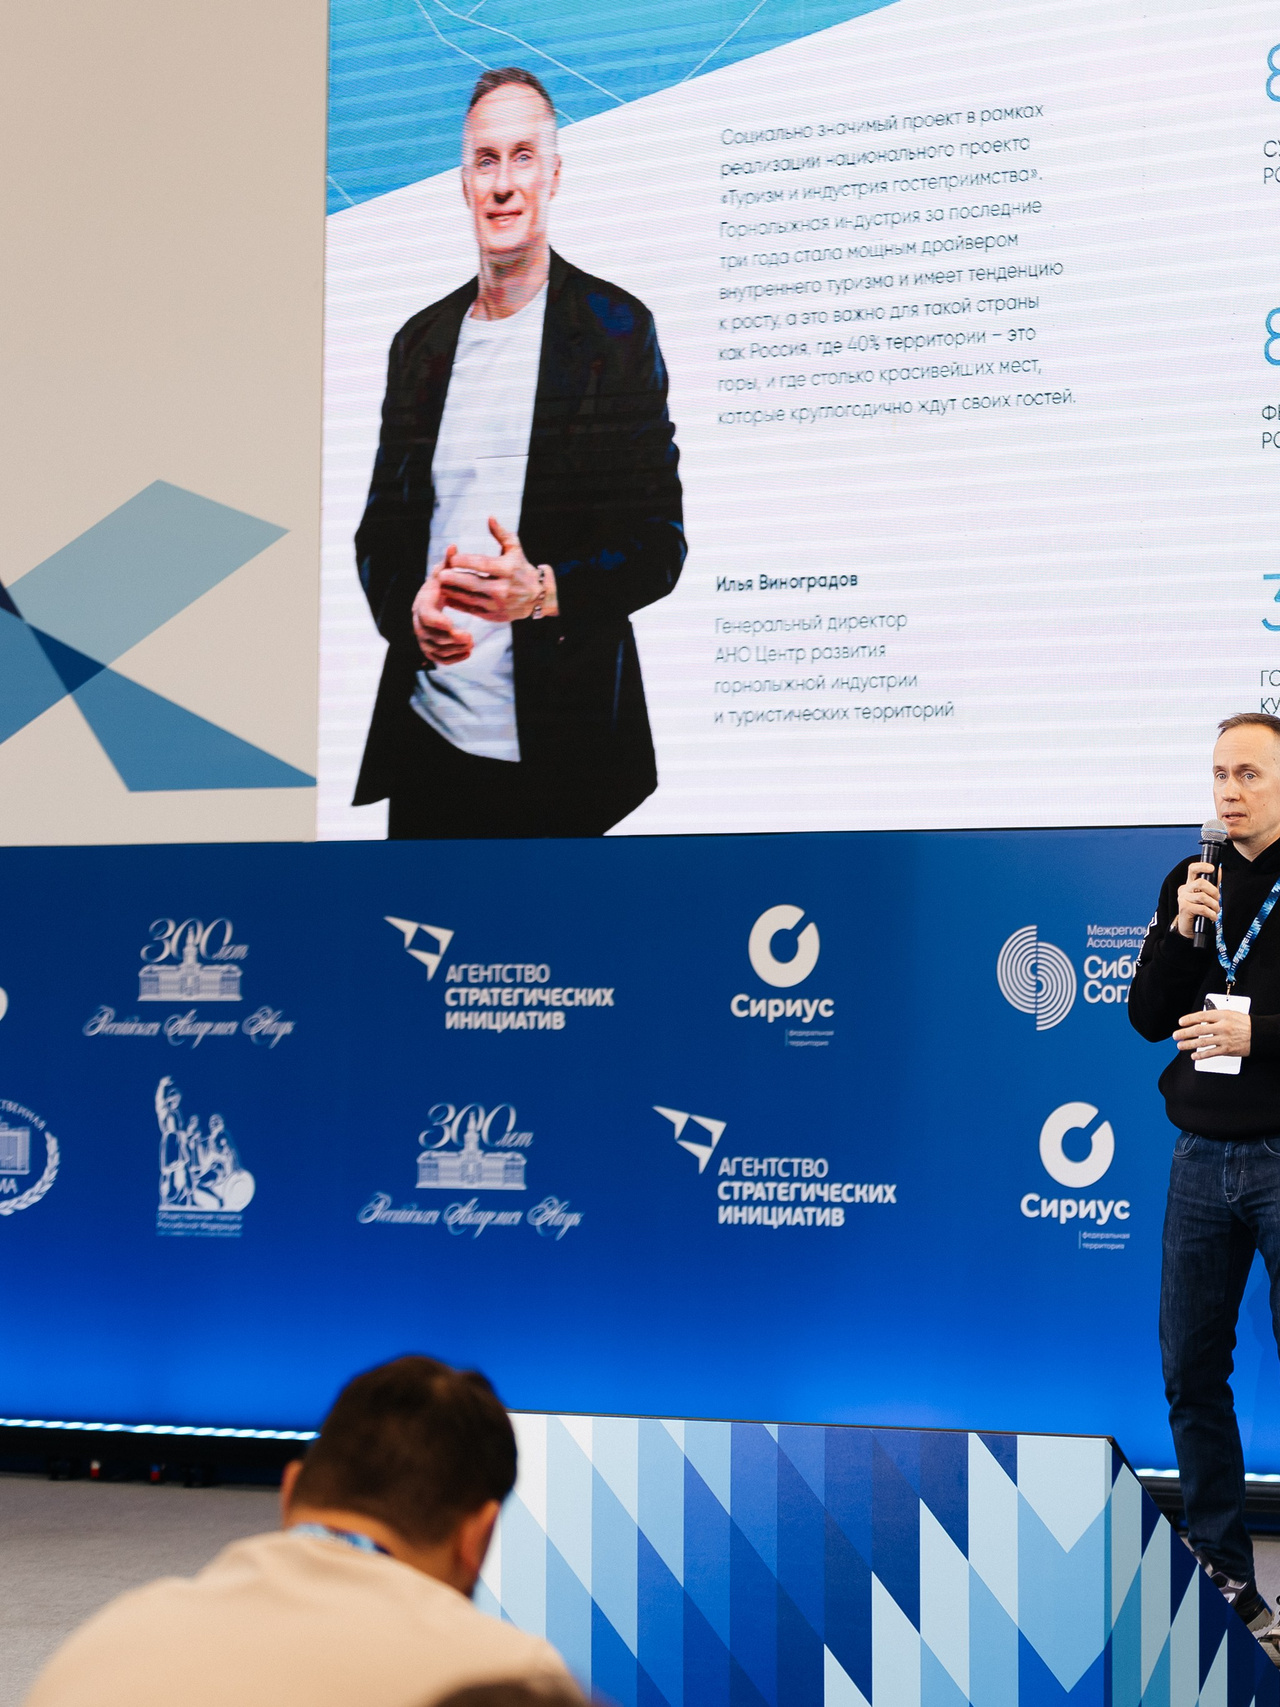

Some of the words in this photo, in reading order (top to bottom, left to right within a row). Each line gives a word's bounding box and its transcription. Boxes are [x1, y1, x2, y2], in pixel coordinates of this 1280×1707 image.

[722, 126, 814, 146] Социально
[818, 115, 898, 138] значимый
[903, 111, 962, 132] проект
[967, 112, 975, 123] в
[981, 104, 1044, 126] рамках
[720, 219, 830, 240] Горнолыжная
[835, 211, 920, 232] индустрия
[926, 209, 944, 222] за
[949, 201, 1042, 222] последние
[720, 254, 747, 271] три
[753, 251, 789, 269] года
[795, 247, 842, 264] стала
[848, 243, 916, 261] мощным
[922, 233, 1018, 256] драйвером
[719, 280, 822, 304] внутреннего
[827, 274, 894, 297] туризма
[900, 273, 909, 287] и
[914, 269, 965, 285] имеет
[968, 261, 1064, 283] тенденцию
[719, 318, 727, 331] к
[786, 314, 797, 327] а
[801, 311, 829, 326] это
[834, 307, 886, 323] важно
[890, 305, 920, 321] для
[924, 298, 972, 316] такой
[976, 295, 1040, 314] страны
[718, 347, 747, 362] как
[816, 339, 843, 356] где
[847, 335, 881, 352] 40%
[885, 329, 986, 352] территории
[1007, 327, 1036, 341] это
[766, 376, 775, 388] и
[780, 373, 807, 389] где
[810, 368, 874, 386] столько
[879, 359, 994, 382] красивейших
[718, 410, 786, 427] которые
[790, 401, 913, 425] круглогодично
[918, 397, 957, 417] ждут
[962, 394, 1011, 411] своих
[716, 575, 753, 592] Илья
[759, 573, 858, 593] Виноградов
[715, 615, 823, 637] Генеральный
[827, 612, 908, 634] директор
[715, 646, 751, 663] АНО
[755, 645, 807, 665] Центр
[811, 643, 886, 665] развития
[714, 675, 826, 697] горнолыжной
[831, 673, 918, 694] индустрии
[715, 712, 723, 724] и
[729, 706, 849, 727] туристических
[854, 701, 955, 722] территорий
[445, 964, 550, 983] АГЕНТСТВО
[445, 987, 615, 1007] СТРАТЕГИЧЕСКИХ
[730, 993, 835, 1023] Сириус
[445, 1011, 566, 1033] ИНИЦИАТИВ
[718, 1157, 829, 1178] АГЕНТСТВО
[717, 1181, 897, 1204] СТРАТЕГИЧЕСКИХ
[718, 1205, 845, 1230] ИНИЦИАТИВ
[1020, 1192, 1131, 1225] Сириус
